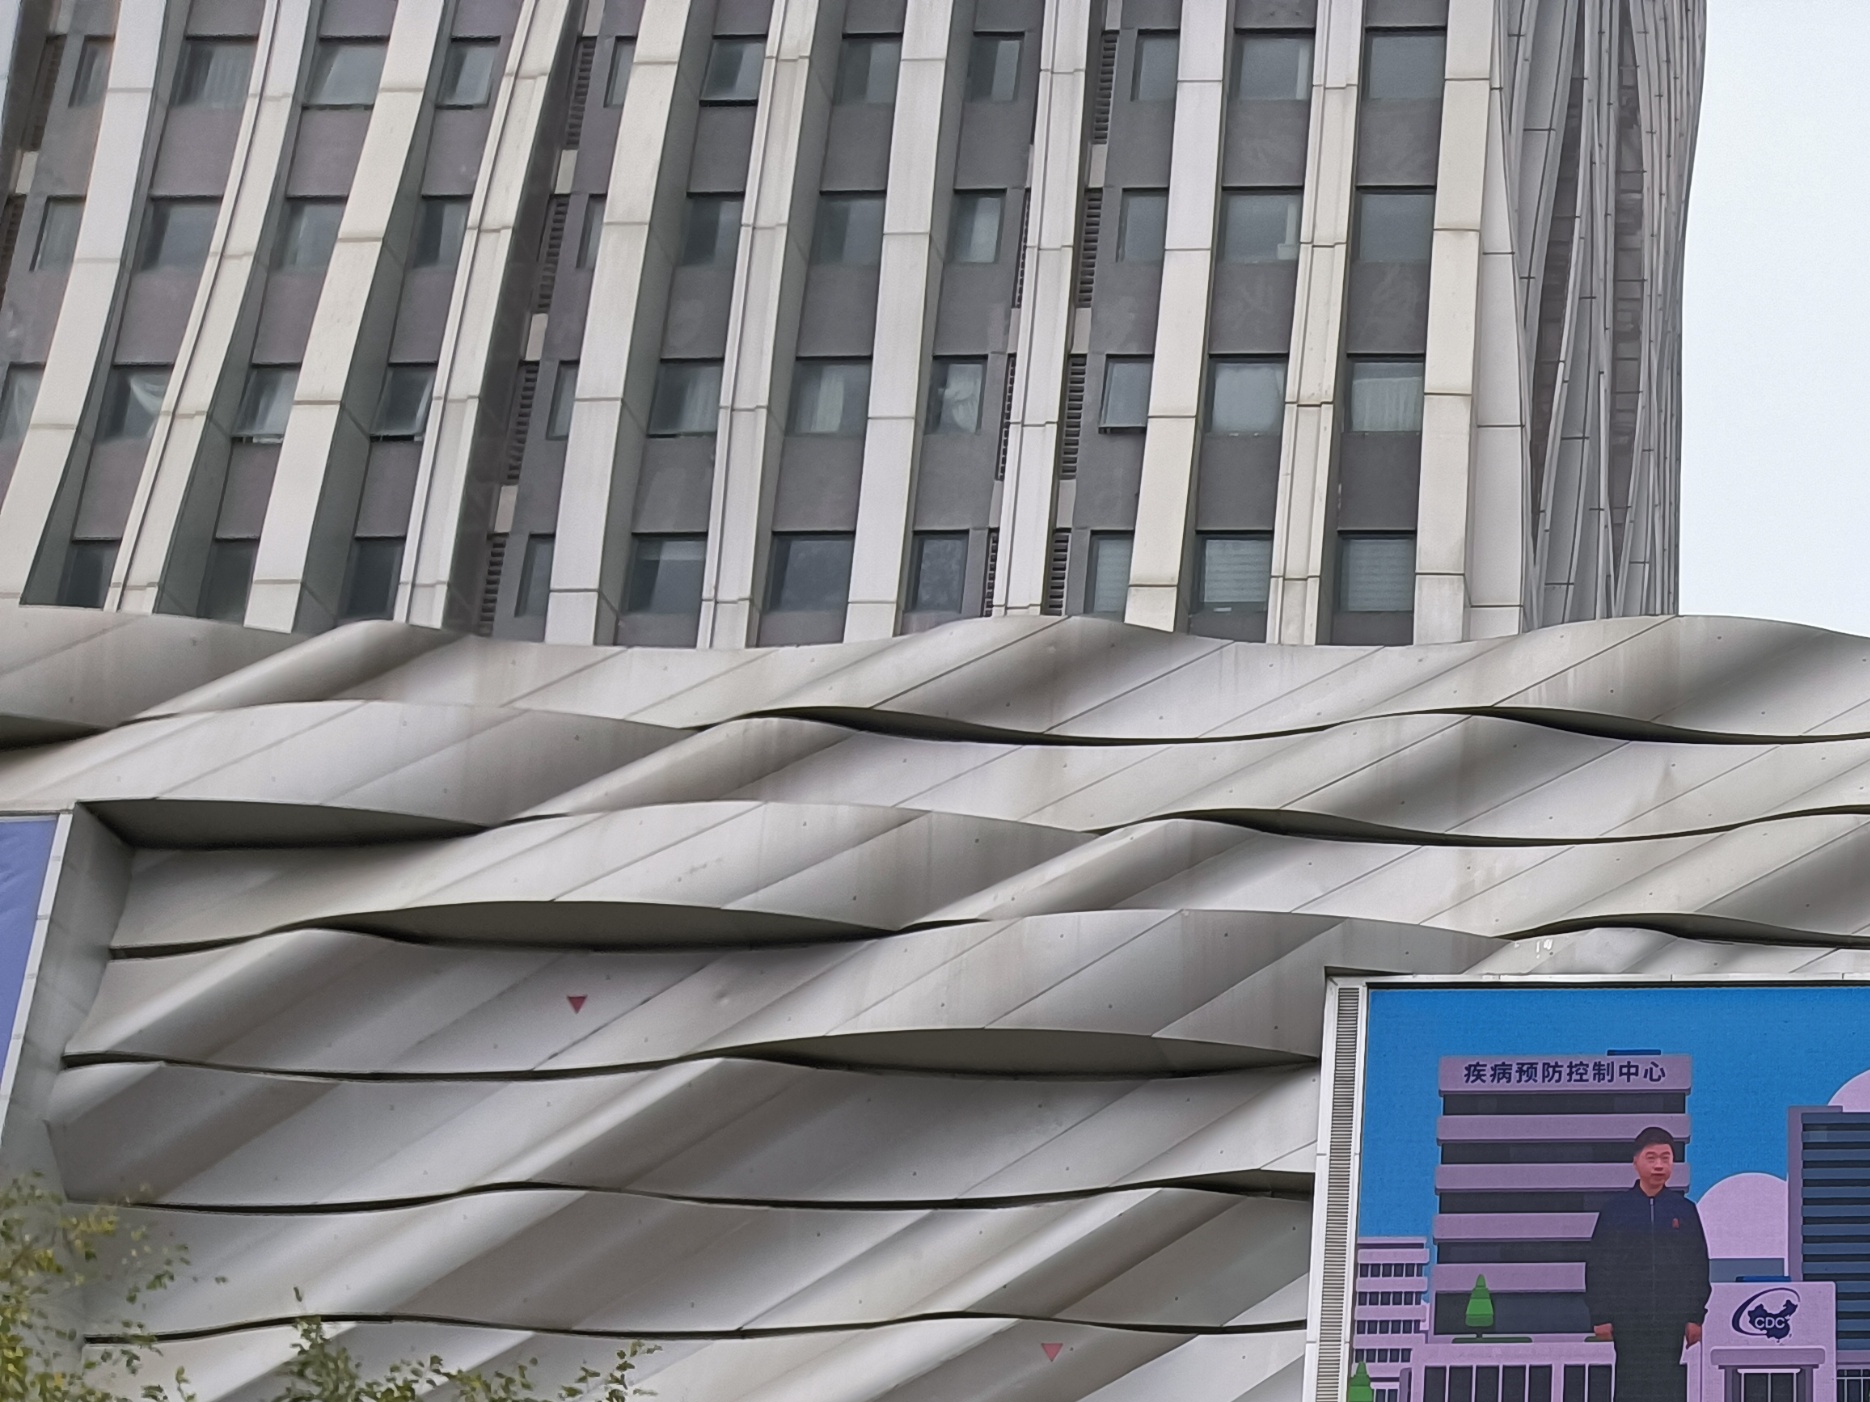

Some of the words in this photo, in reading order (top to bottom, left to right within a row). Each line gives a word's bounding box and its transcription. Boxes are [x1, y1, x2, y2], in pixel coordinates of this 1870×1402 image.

[1463, 1060, 1666, 1084] 疾病预防控制中心
[1754, 1316, 1786, 1329] CDC
